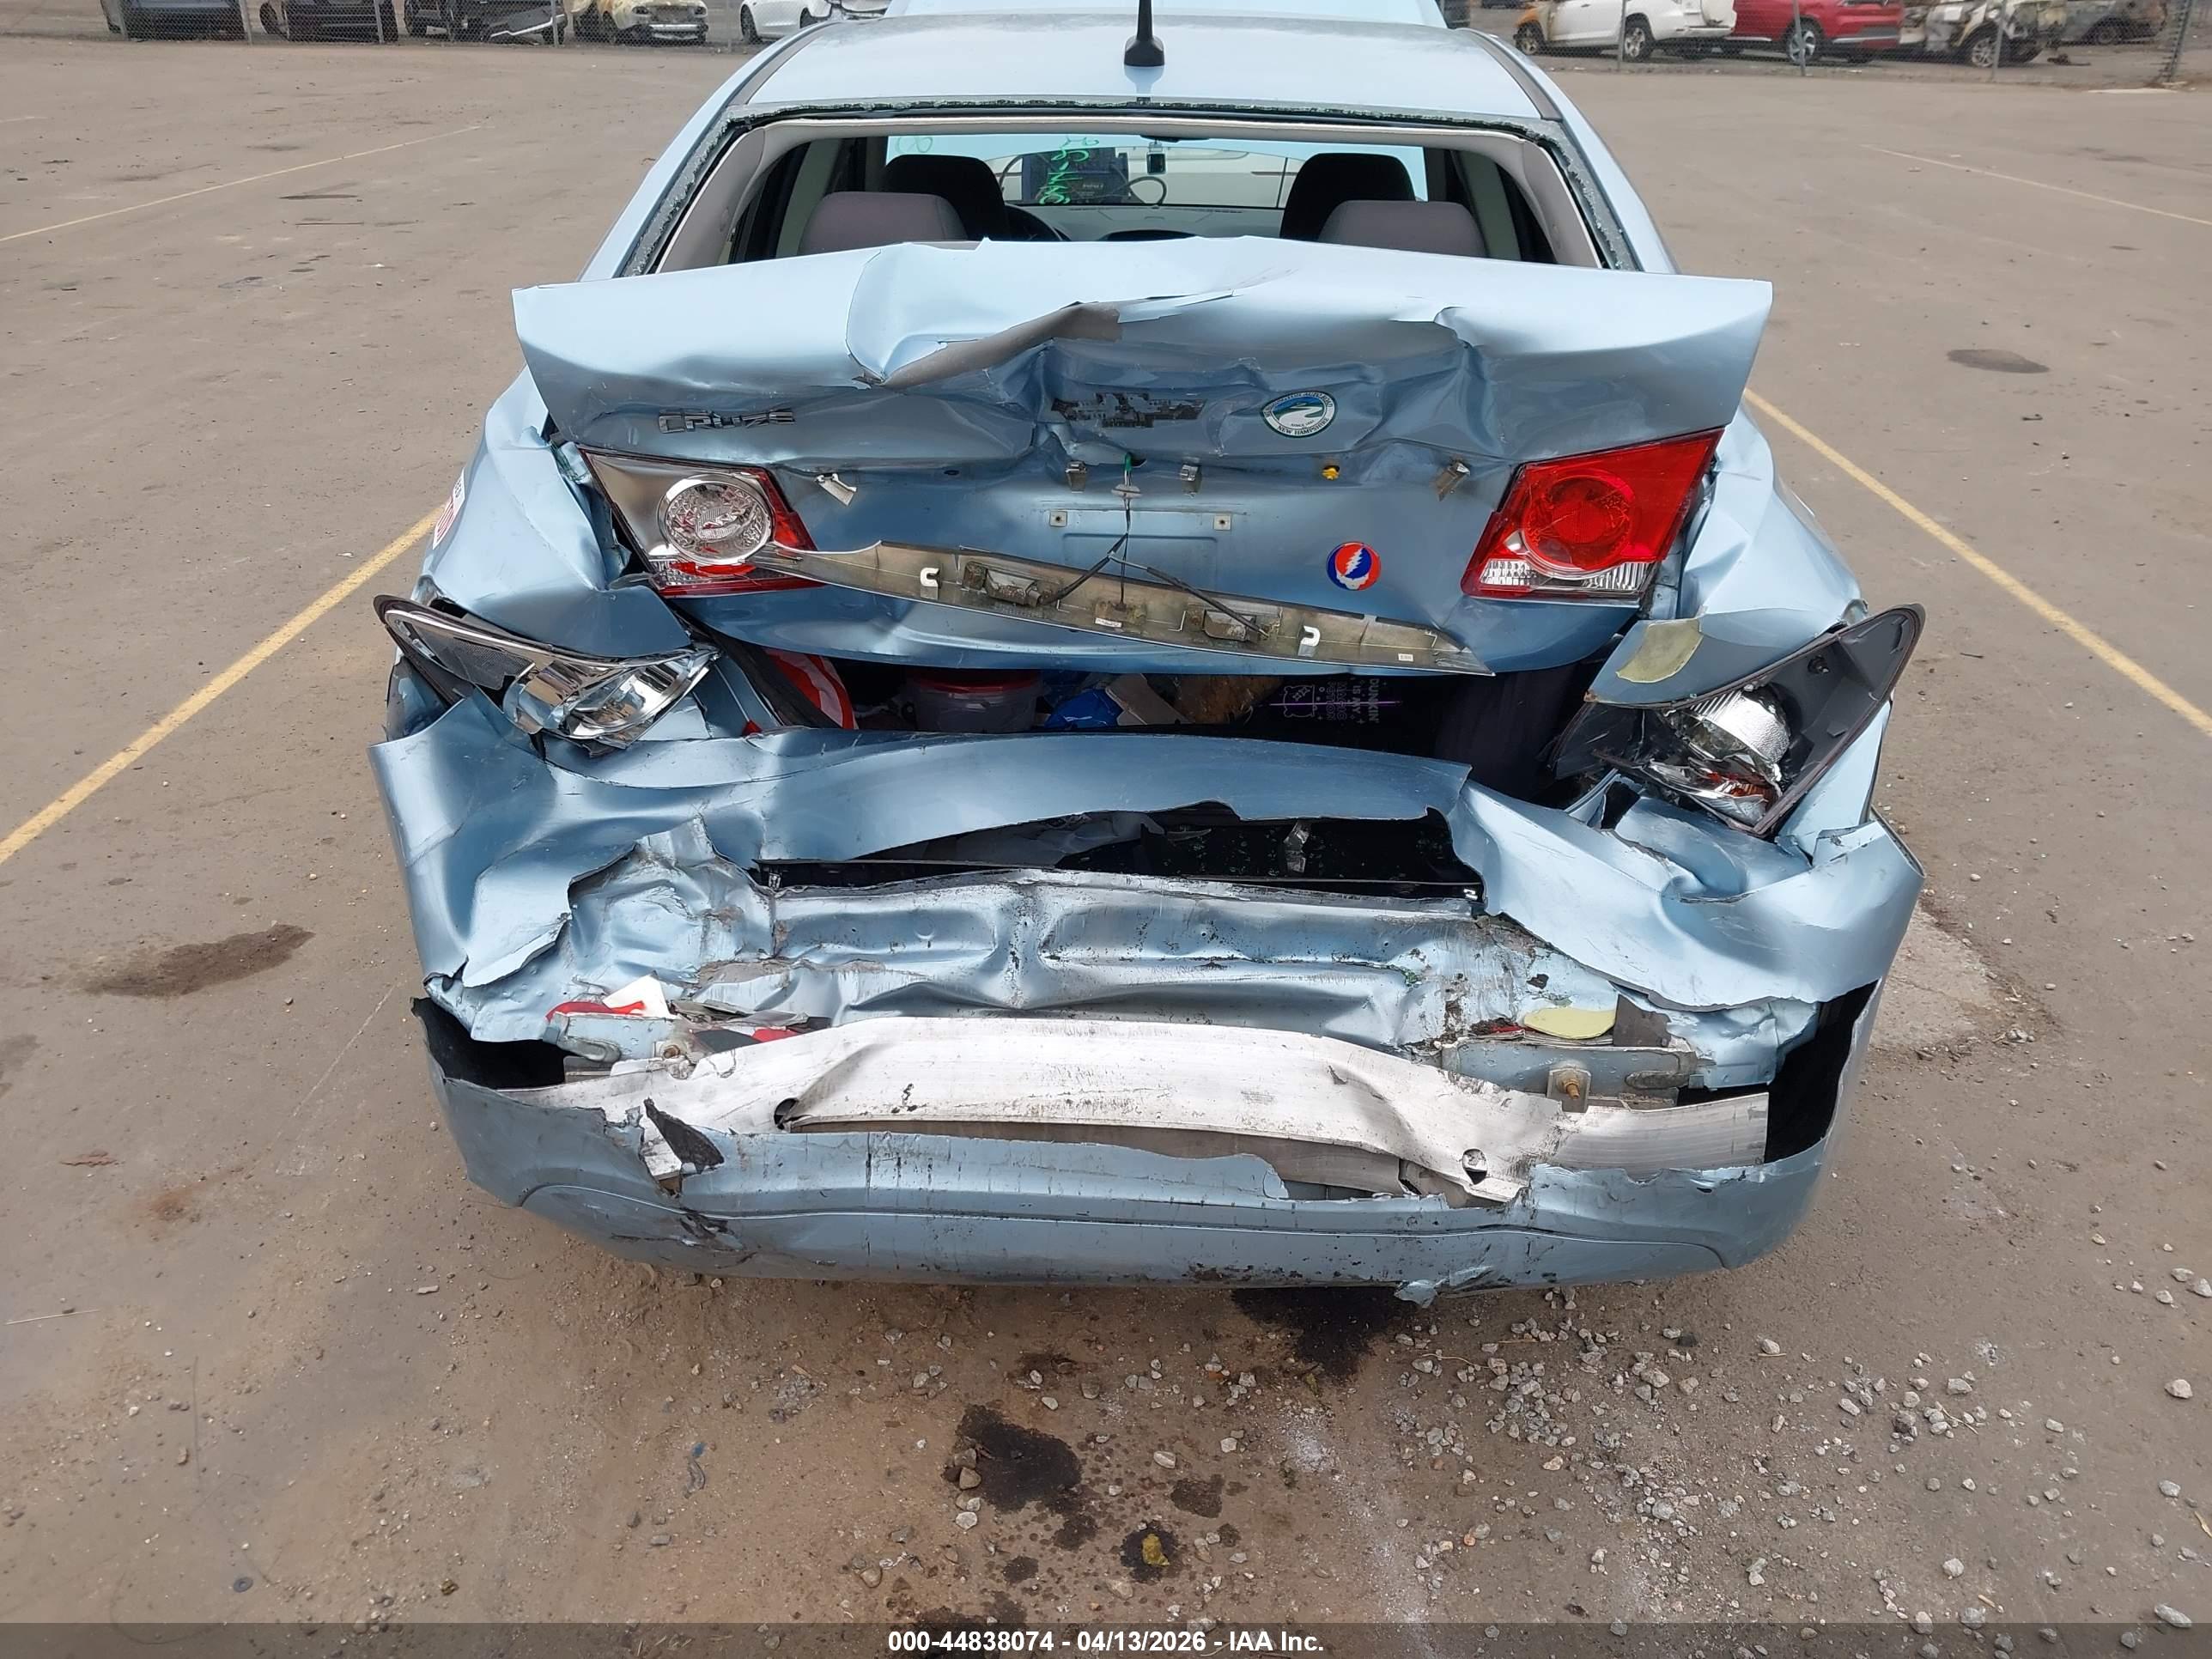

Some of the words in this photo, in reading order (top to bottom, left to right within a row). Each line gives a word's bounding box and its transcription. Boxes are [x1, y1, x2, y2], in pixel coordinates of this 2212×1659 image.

[659, 409, 795, 434] CRUZE
[1278, 425, 1292, 434] NEW
[1294, 417, 1330, 435] HAMPSHIRE
[1352, 684, 1361, 695] IS
